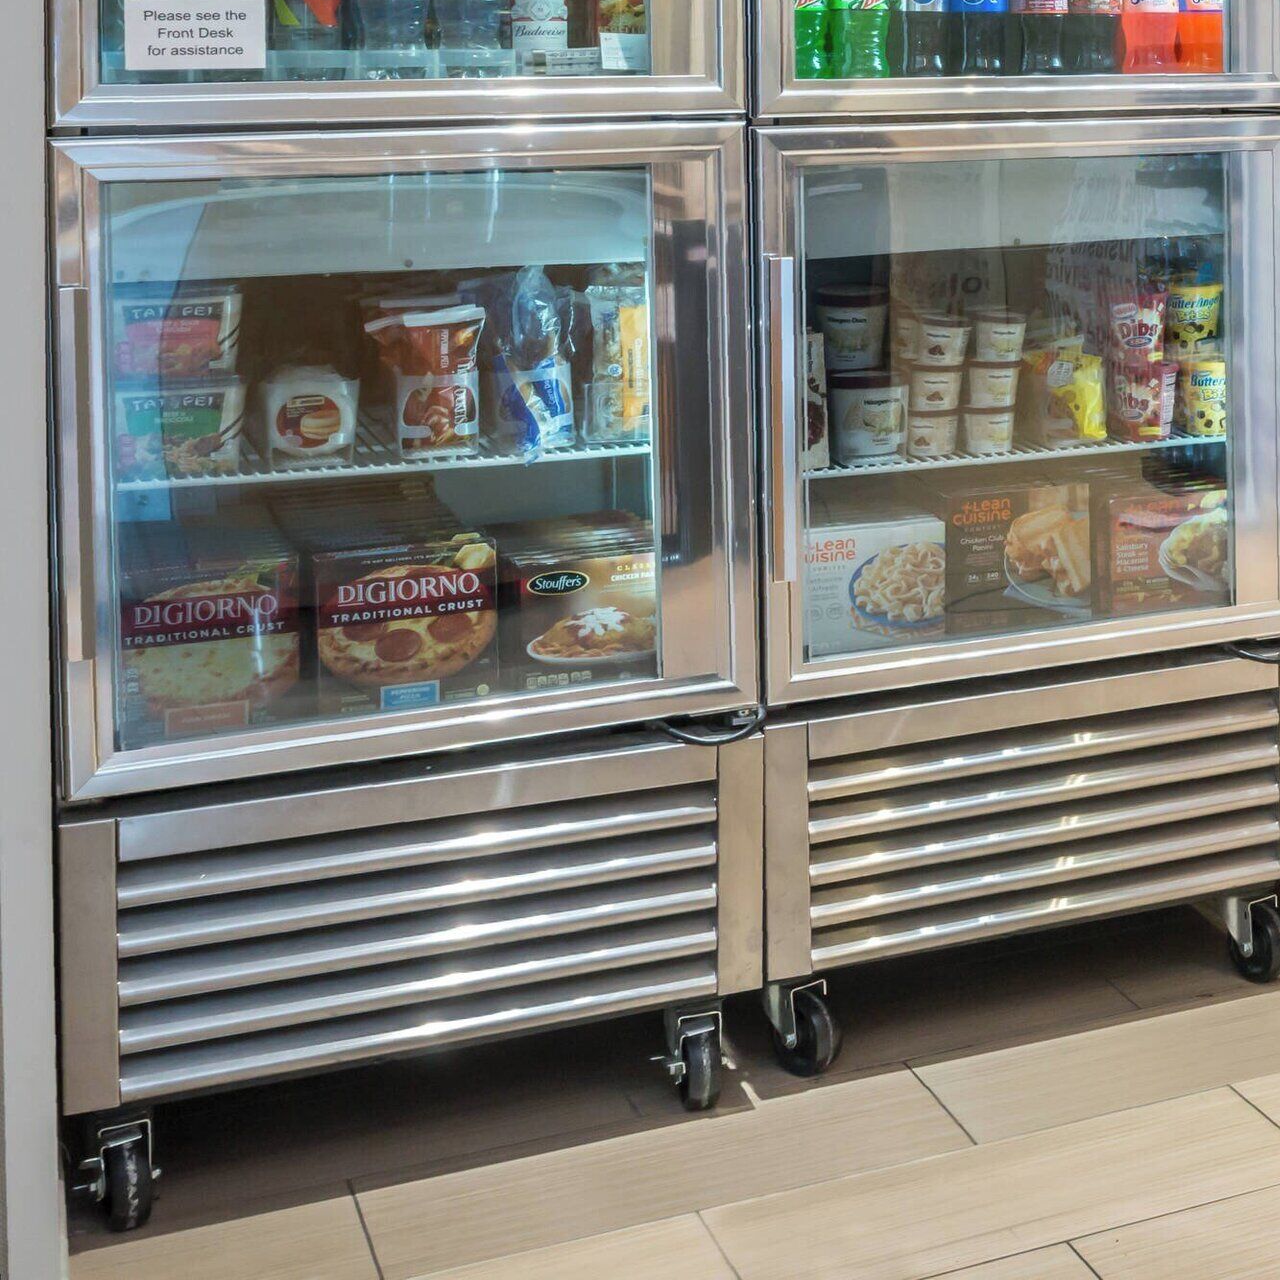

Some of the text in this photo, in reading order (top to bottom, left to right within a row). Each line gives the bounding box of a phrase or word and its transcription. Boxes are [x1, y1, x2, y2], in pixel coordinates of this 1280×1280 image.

[142, 9, 248, 23] Please see the
[156, 26, 235, 39] Front Desk
[513, 24, 568, 41] Budweiser
[147, 43, 245, 57] for assistance
[130, 304, 214, 318] TAI PEI
[1118, 319, 1158, 338] Dibs
[181, 395, 214, 409] PEI
[973, 497, 1011, 512] Lean
[952, 508, 1013, 526] Cuisine
[815, 538, 856, 552] Lean
[336, 571, 481, 608] DIGIORNO
[534, 575, 583, 592] Stouffer's
[133, 593, 279, 628] DIGIORNO
[331, 598, 484, 624] TRADITIONAL CRUST
[124, 620, 285, 646] TRADITIONAL CRUST
